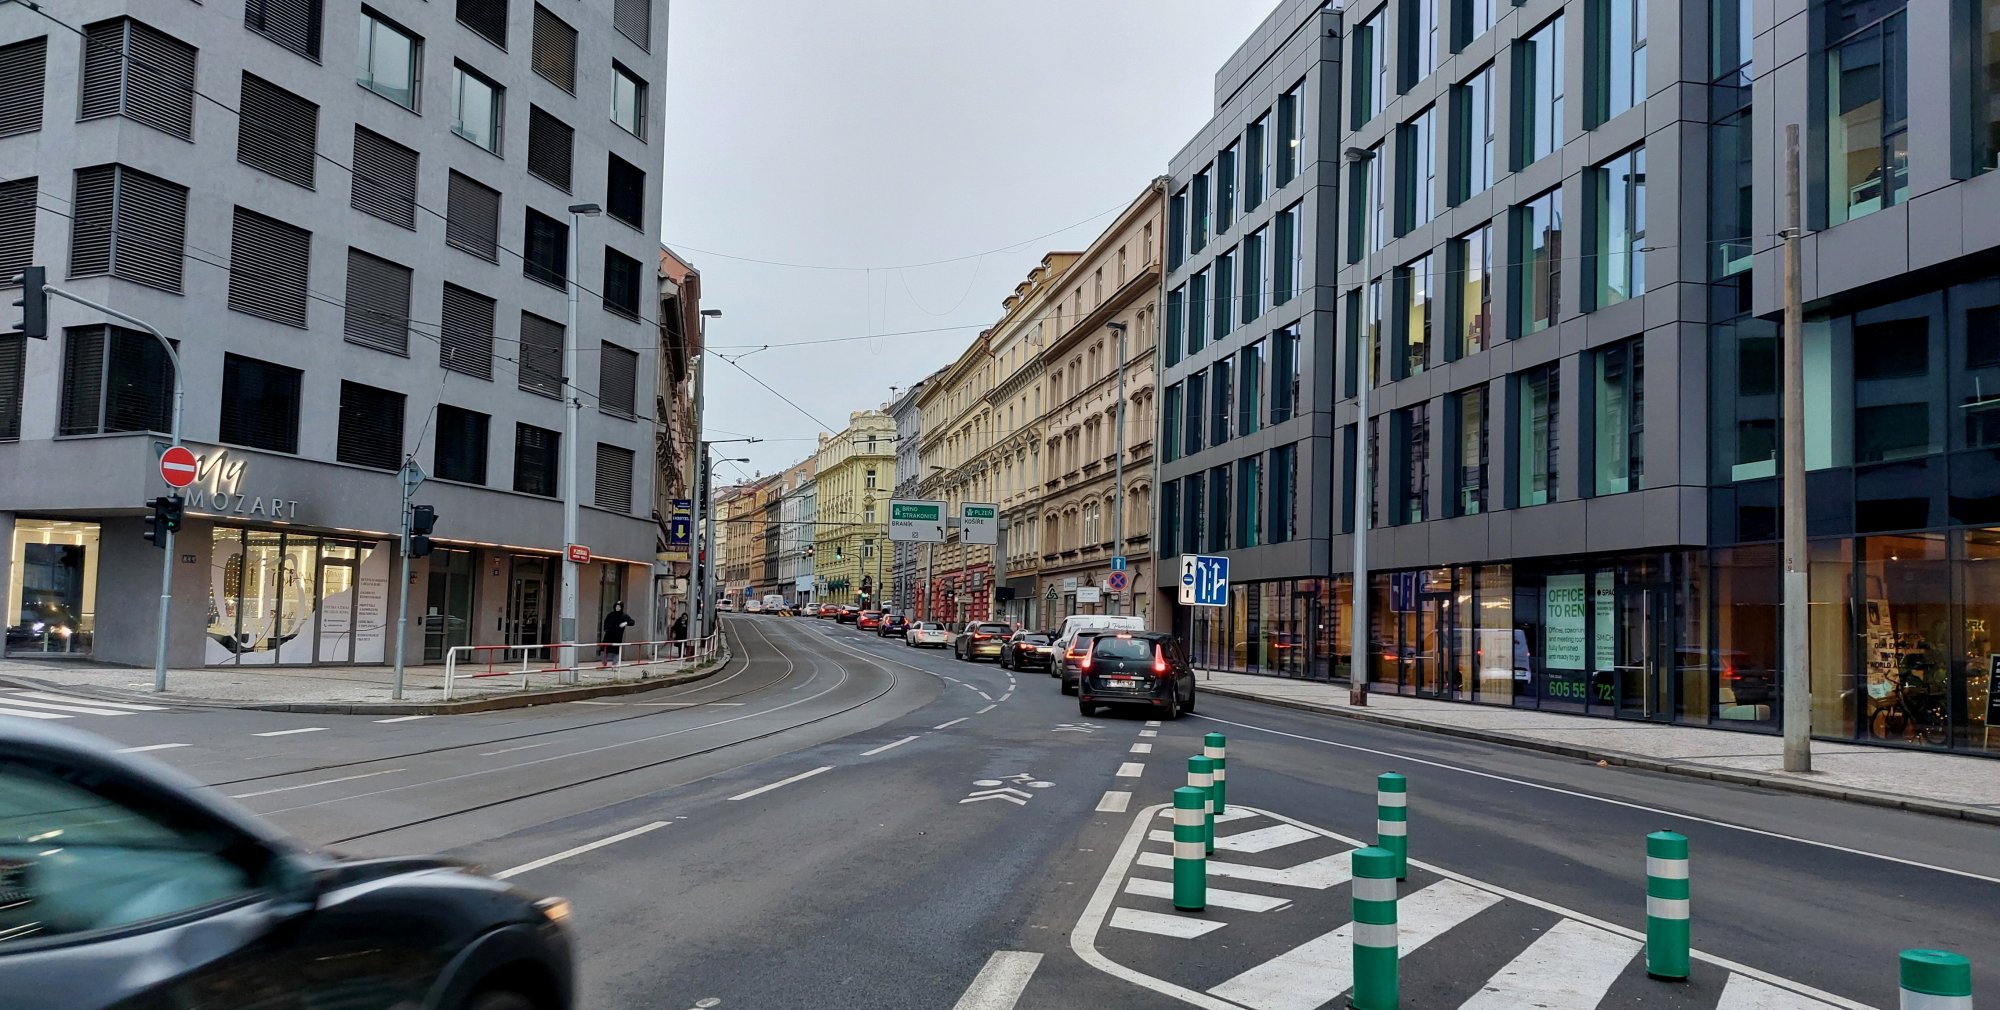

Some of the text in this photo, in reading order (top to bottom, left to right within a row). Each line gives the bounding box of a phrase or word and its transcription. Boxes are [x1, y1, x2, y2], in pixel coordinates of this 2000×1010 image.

[184, 487, 299, 519] MOZART
[1548, 588, 1584, 602] OFFICE
[1548, 604, 1562, 617] TO
[1549, 681, 1570, 697] 605
